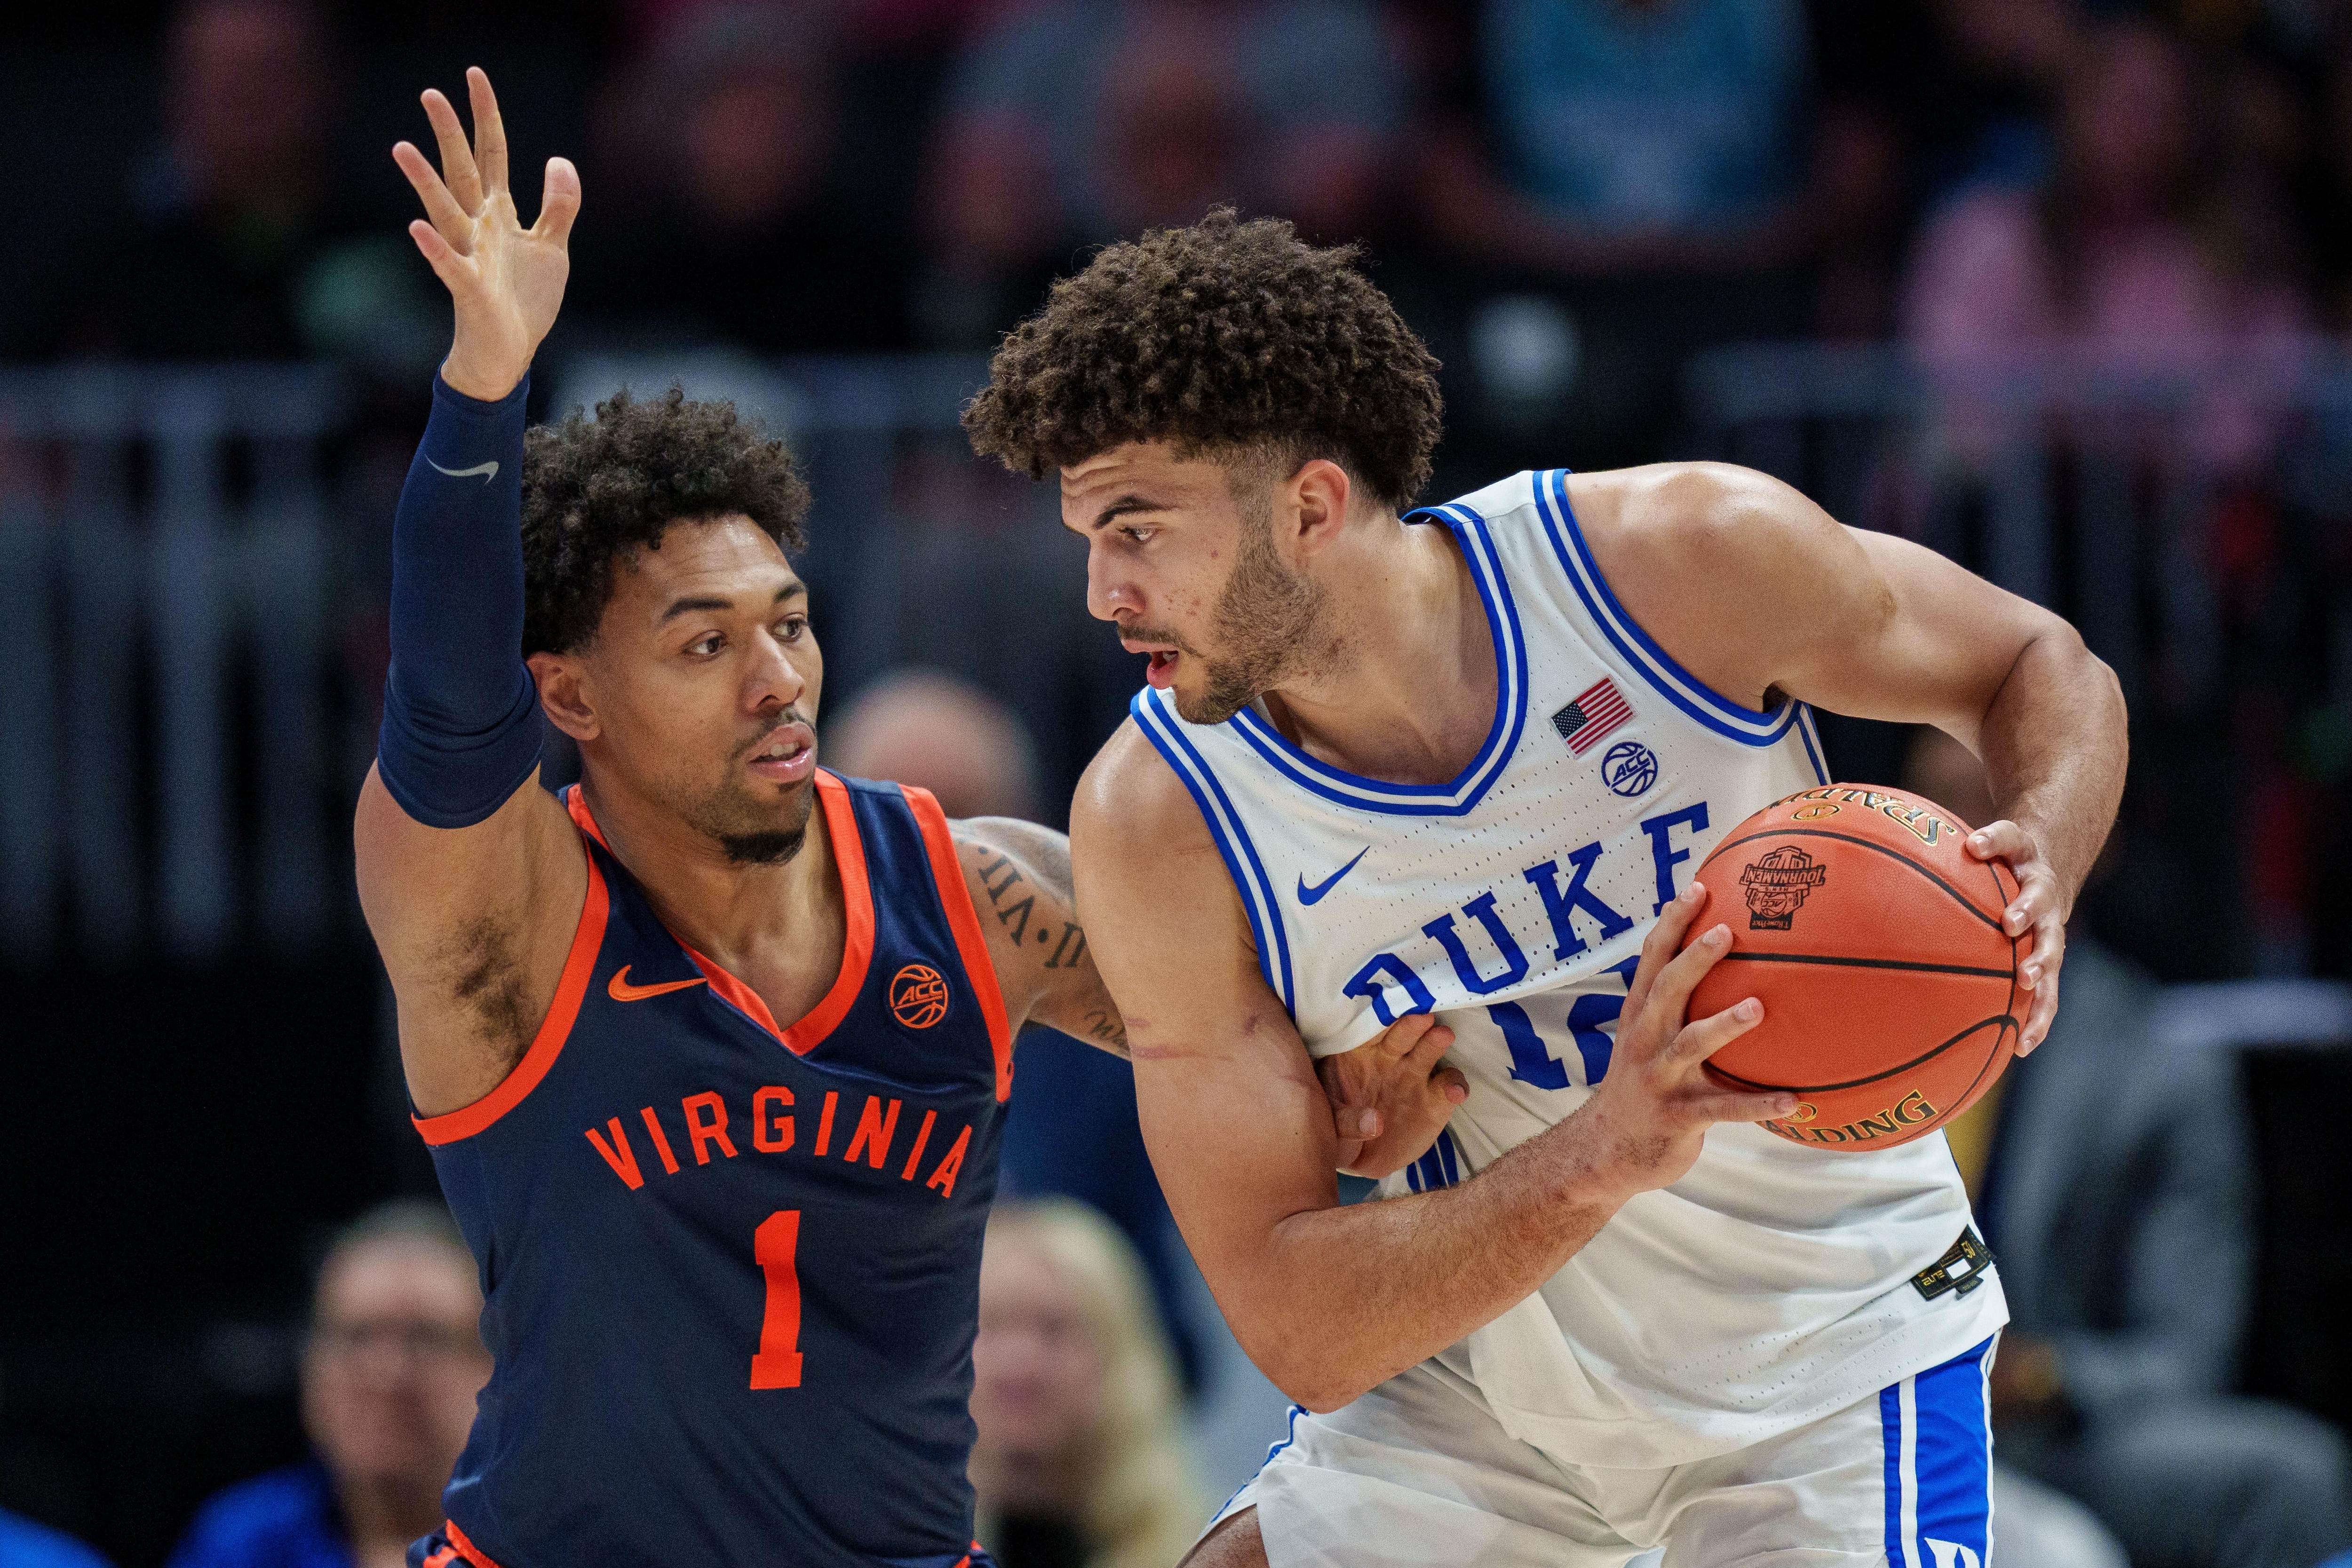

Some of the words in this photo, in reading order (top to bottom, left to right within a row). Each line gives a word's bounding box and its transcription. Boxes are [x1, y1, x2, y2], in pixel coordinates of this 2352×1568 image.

[1613, 748, 1650, 781] ACC
[1739, 863, 1826, 886] TOURNAMENT
[1343, 801, 1709, 1026] DUKE
[898, 980, 943, 1005] ACC
[585, 1086, 972, 1198] VIRGINIA
[750, 1210, 803, 1390] 1
